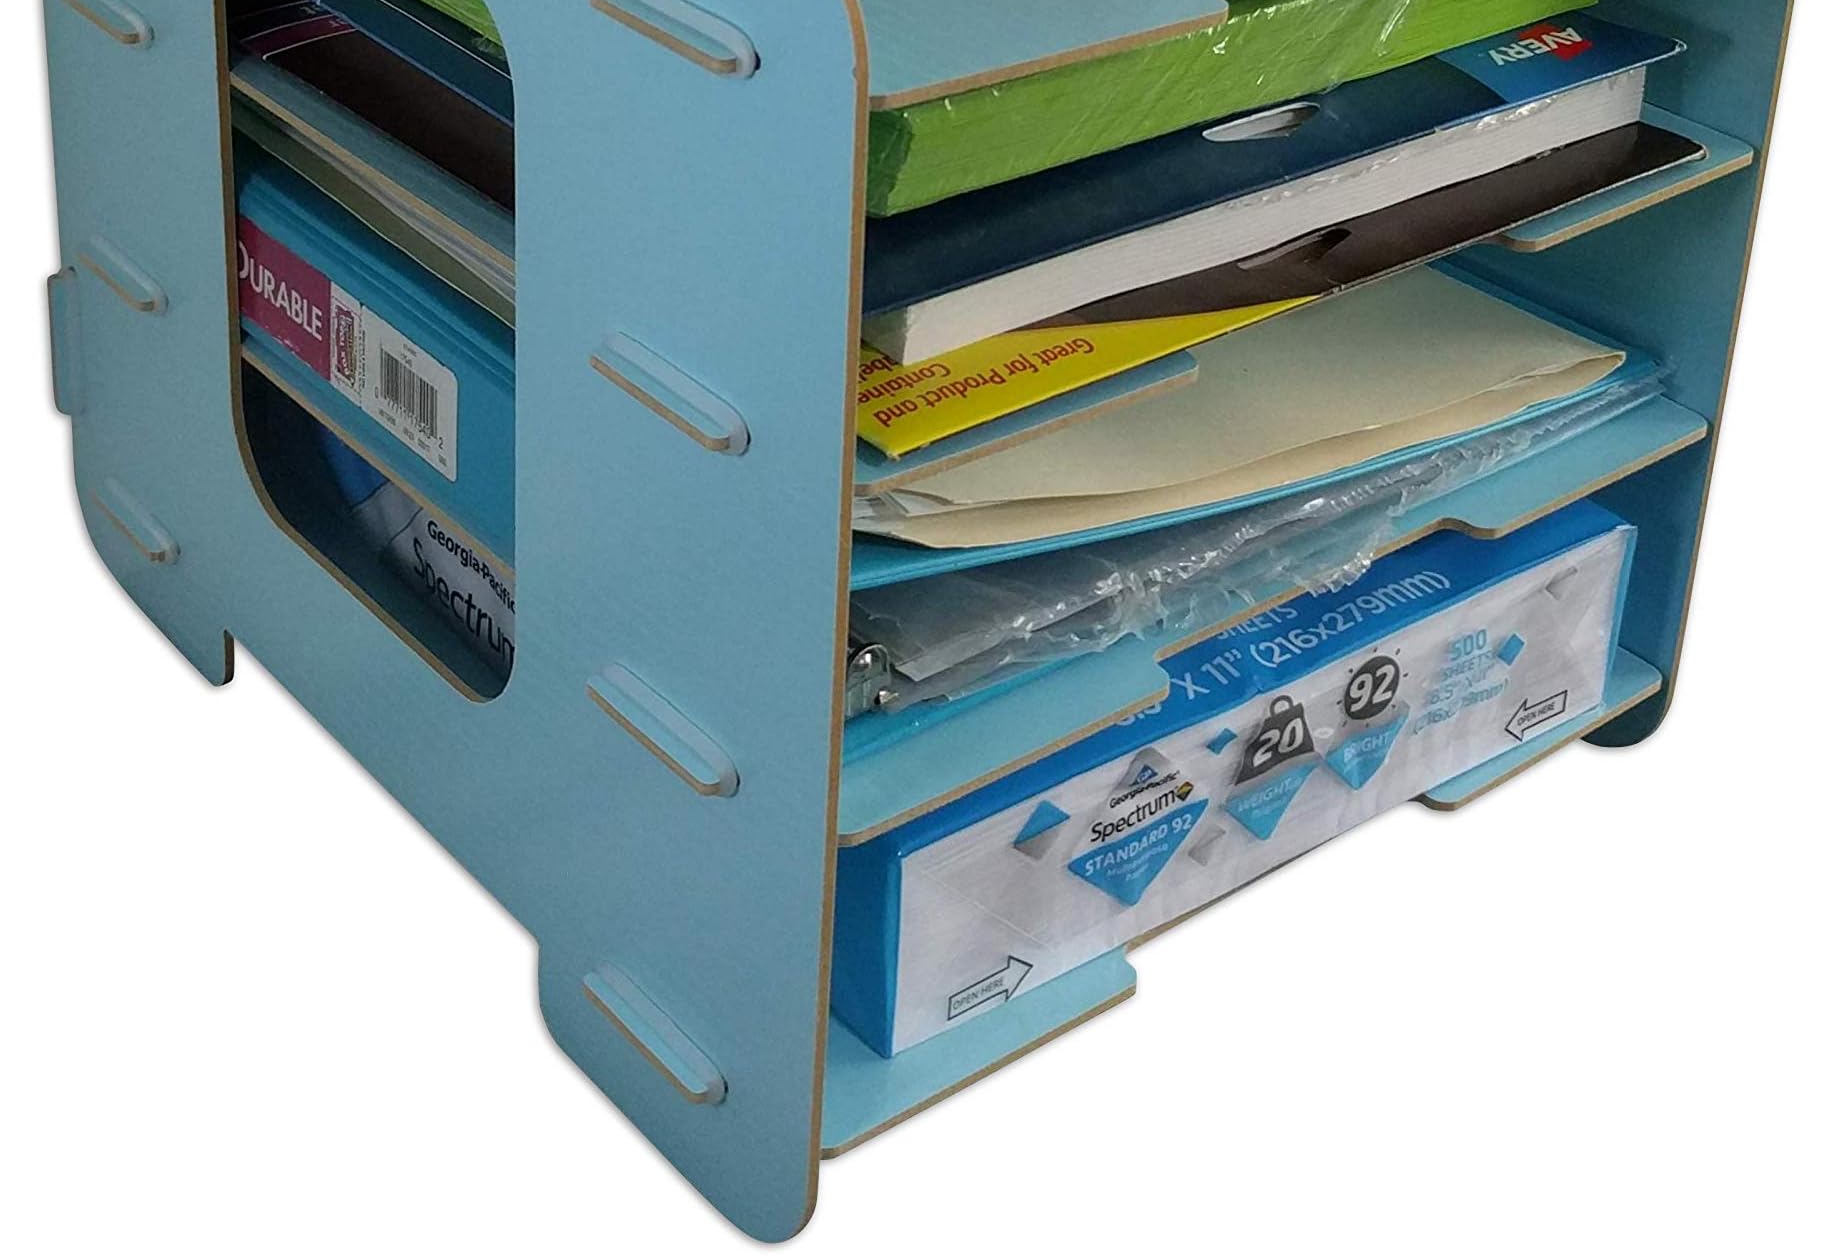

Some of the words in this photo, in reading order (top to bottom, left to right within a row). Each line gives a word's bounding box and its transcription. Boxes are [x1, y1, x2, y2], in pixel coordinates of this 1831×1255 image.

[1488, 27, 1583, 66] AVERY
[1006, 353, 1039, 377] for
[1033, 338, 1095, 366] Great
[858, 363, 951, 404] Containe
[916, 367, 1007, 408] Product
[873, 403, 918, 428] and
[1170, 672, 1210, 700] X
[1249, 570, 1450, 668] (216x279mm)
[1450, 629, 1486, 661] 500
[1349, 663, 1396, 712] 92
[1518, 710, 1537, 726] OPEN
[1538, 701, 1556, 716] HERE
[1252, 717, 1305, 768] 20
[1090, 789, 1176, 843] Spectrum
[1085, 824, 1168, 877] STANDARD
[1171, 813, 1193, 834] 92
[952, 989, 979, 1010] OPEN
[980, 976, 1005, 995] HERE
